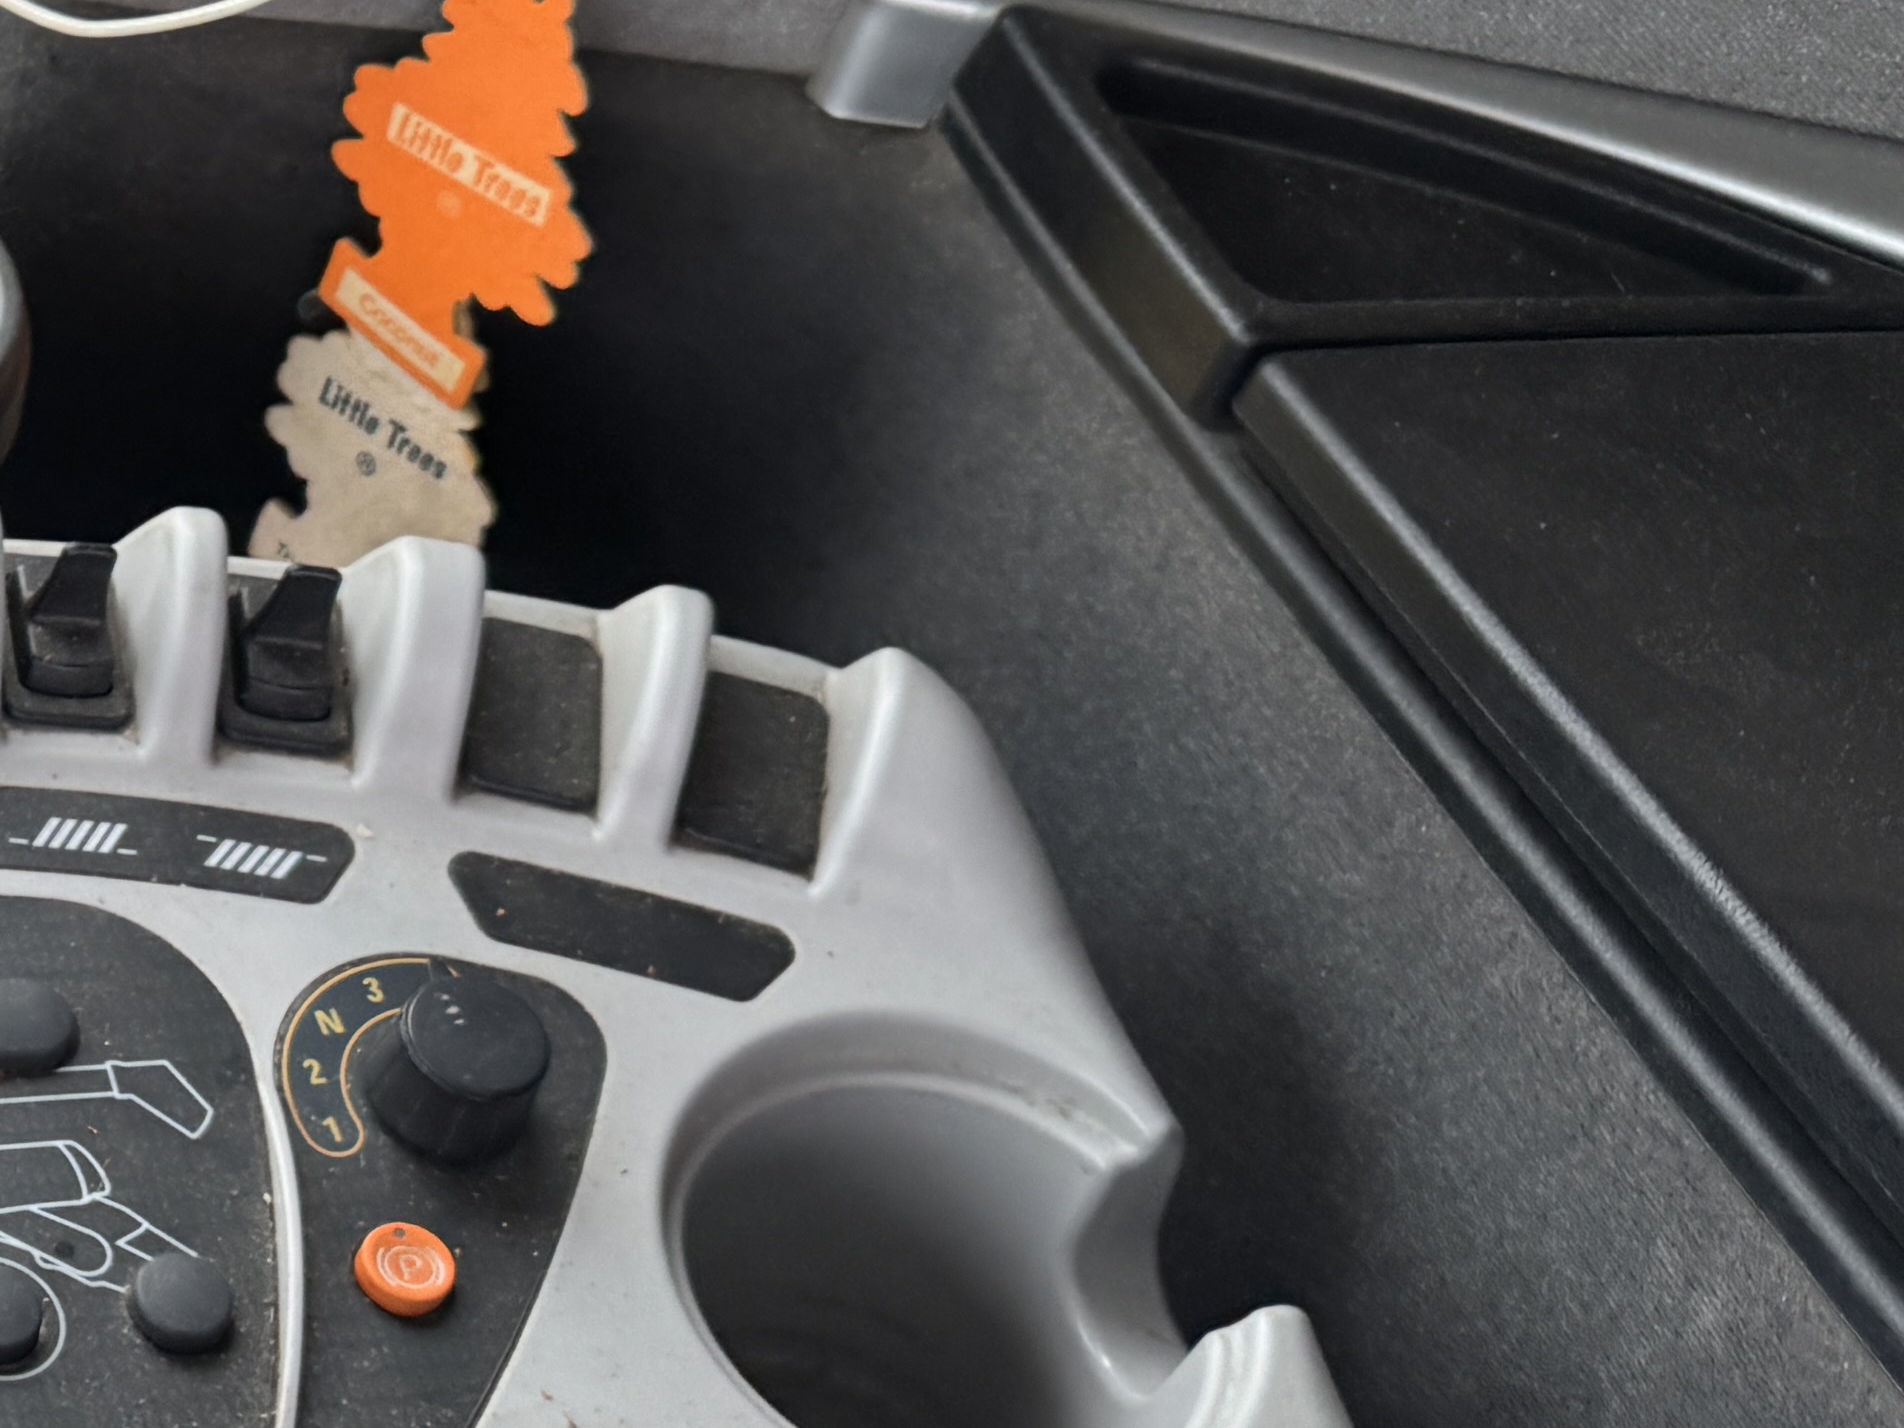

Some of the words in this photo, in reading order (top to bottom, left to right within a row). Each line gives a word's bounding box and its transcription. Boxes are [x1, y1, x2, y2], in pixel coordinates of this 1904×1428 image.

[395, 110, 464, 175] Little
[471, 153, 542, 218] Trees
[318, 375, 379, 436] Little
[386, 419, 447, 480] Trees
[362, 977, 385, 1004] 3
[313, 1008, 346, 1036] N
[302, 1058, 328, 1085] 2
[322, 1116, 343, 1143] 1
[399, 1254, 423, 1281] P
